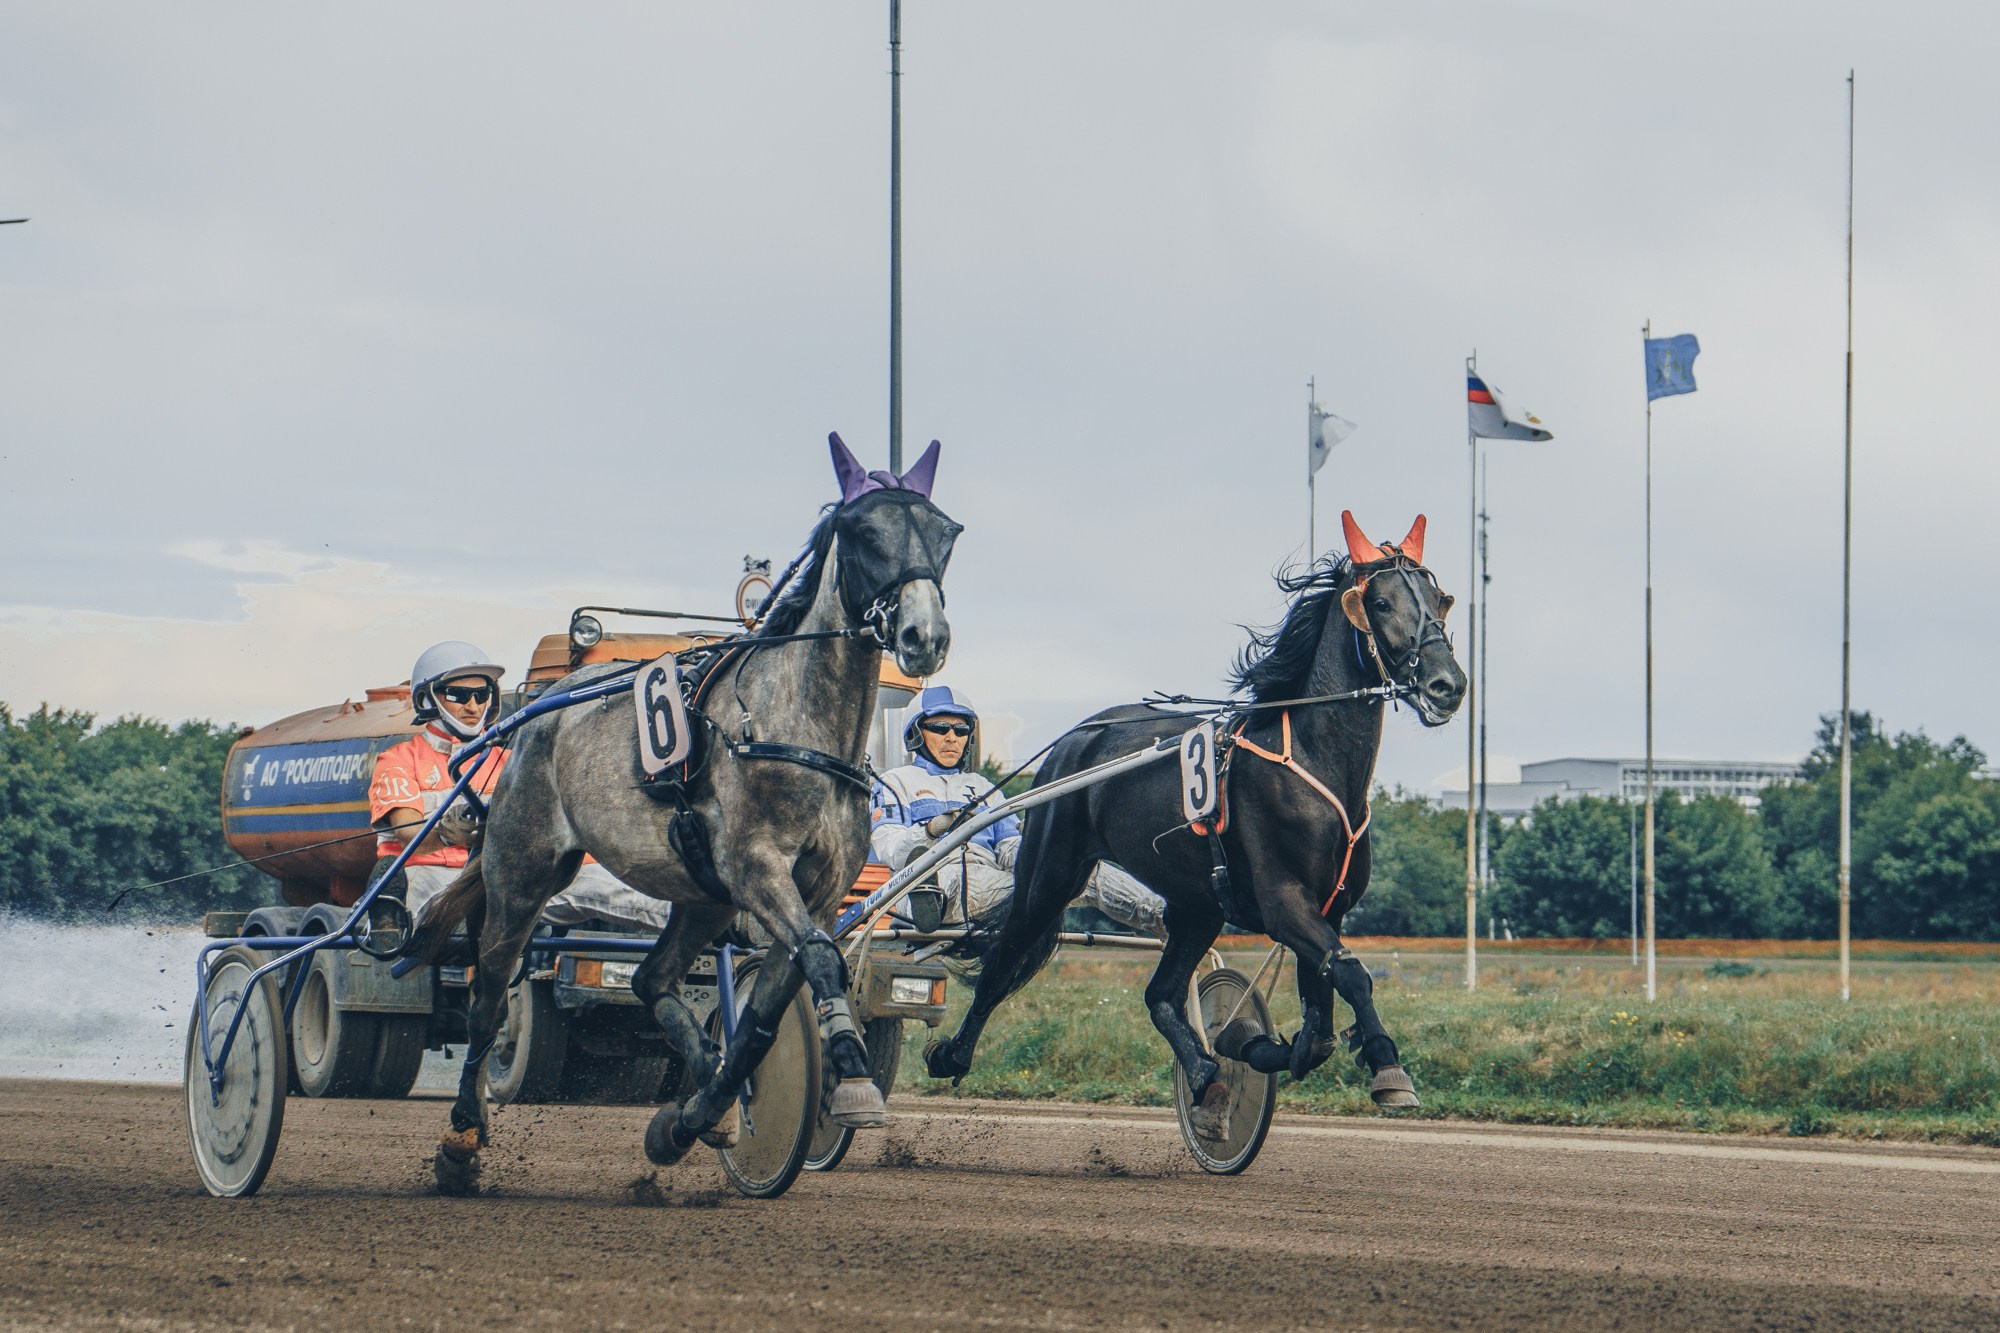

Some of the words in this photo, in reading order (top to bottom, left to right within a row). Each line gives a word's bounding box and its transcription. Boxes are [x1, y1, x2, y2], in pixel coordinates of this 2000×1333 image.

[644, 666, 676, 760] 6
[260, 760, 280, 787] АО
[1187, 732, 1208, 811] 3
